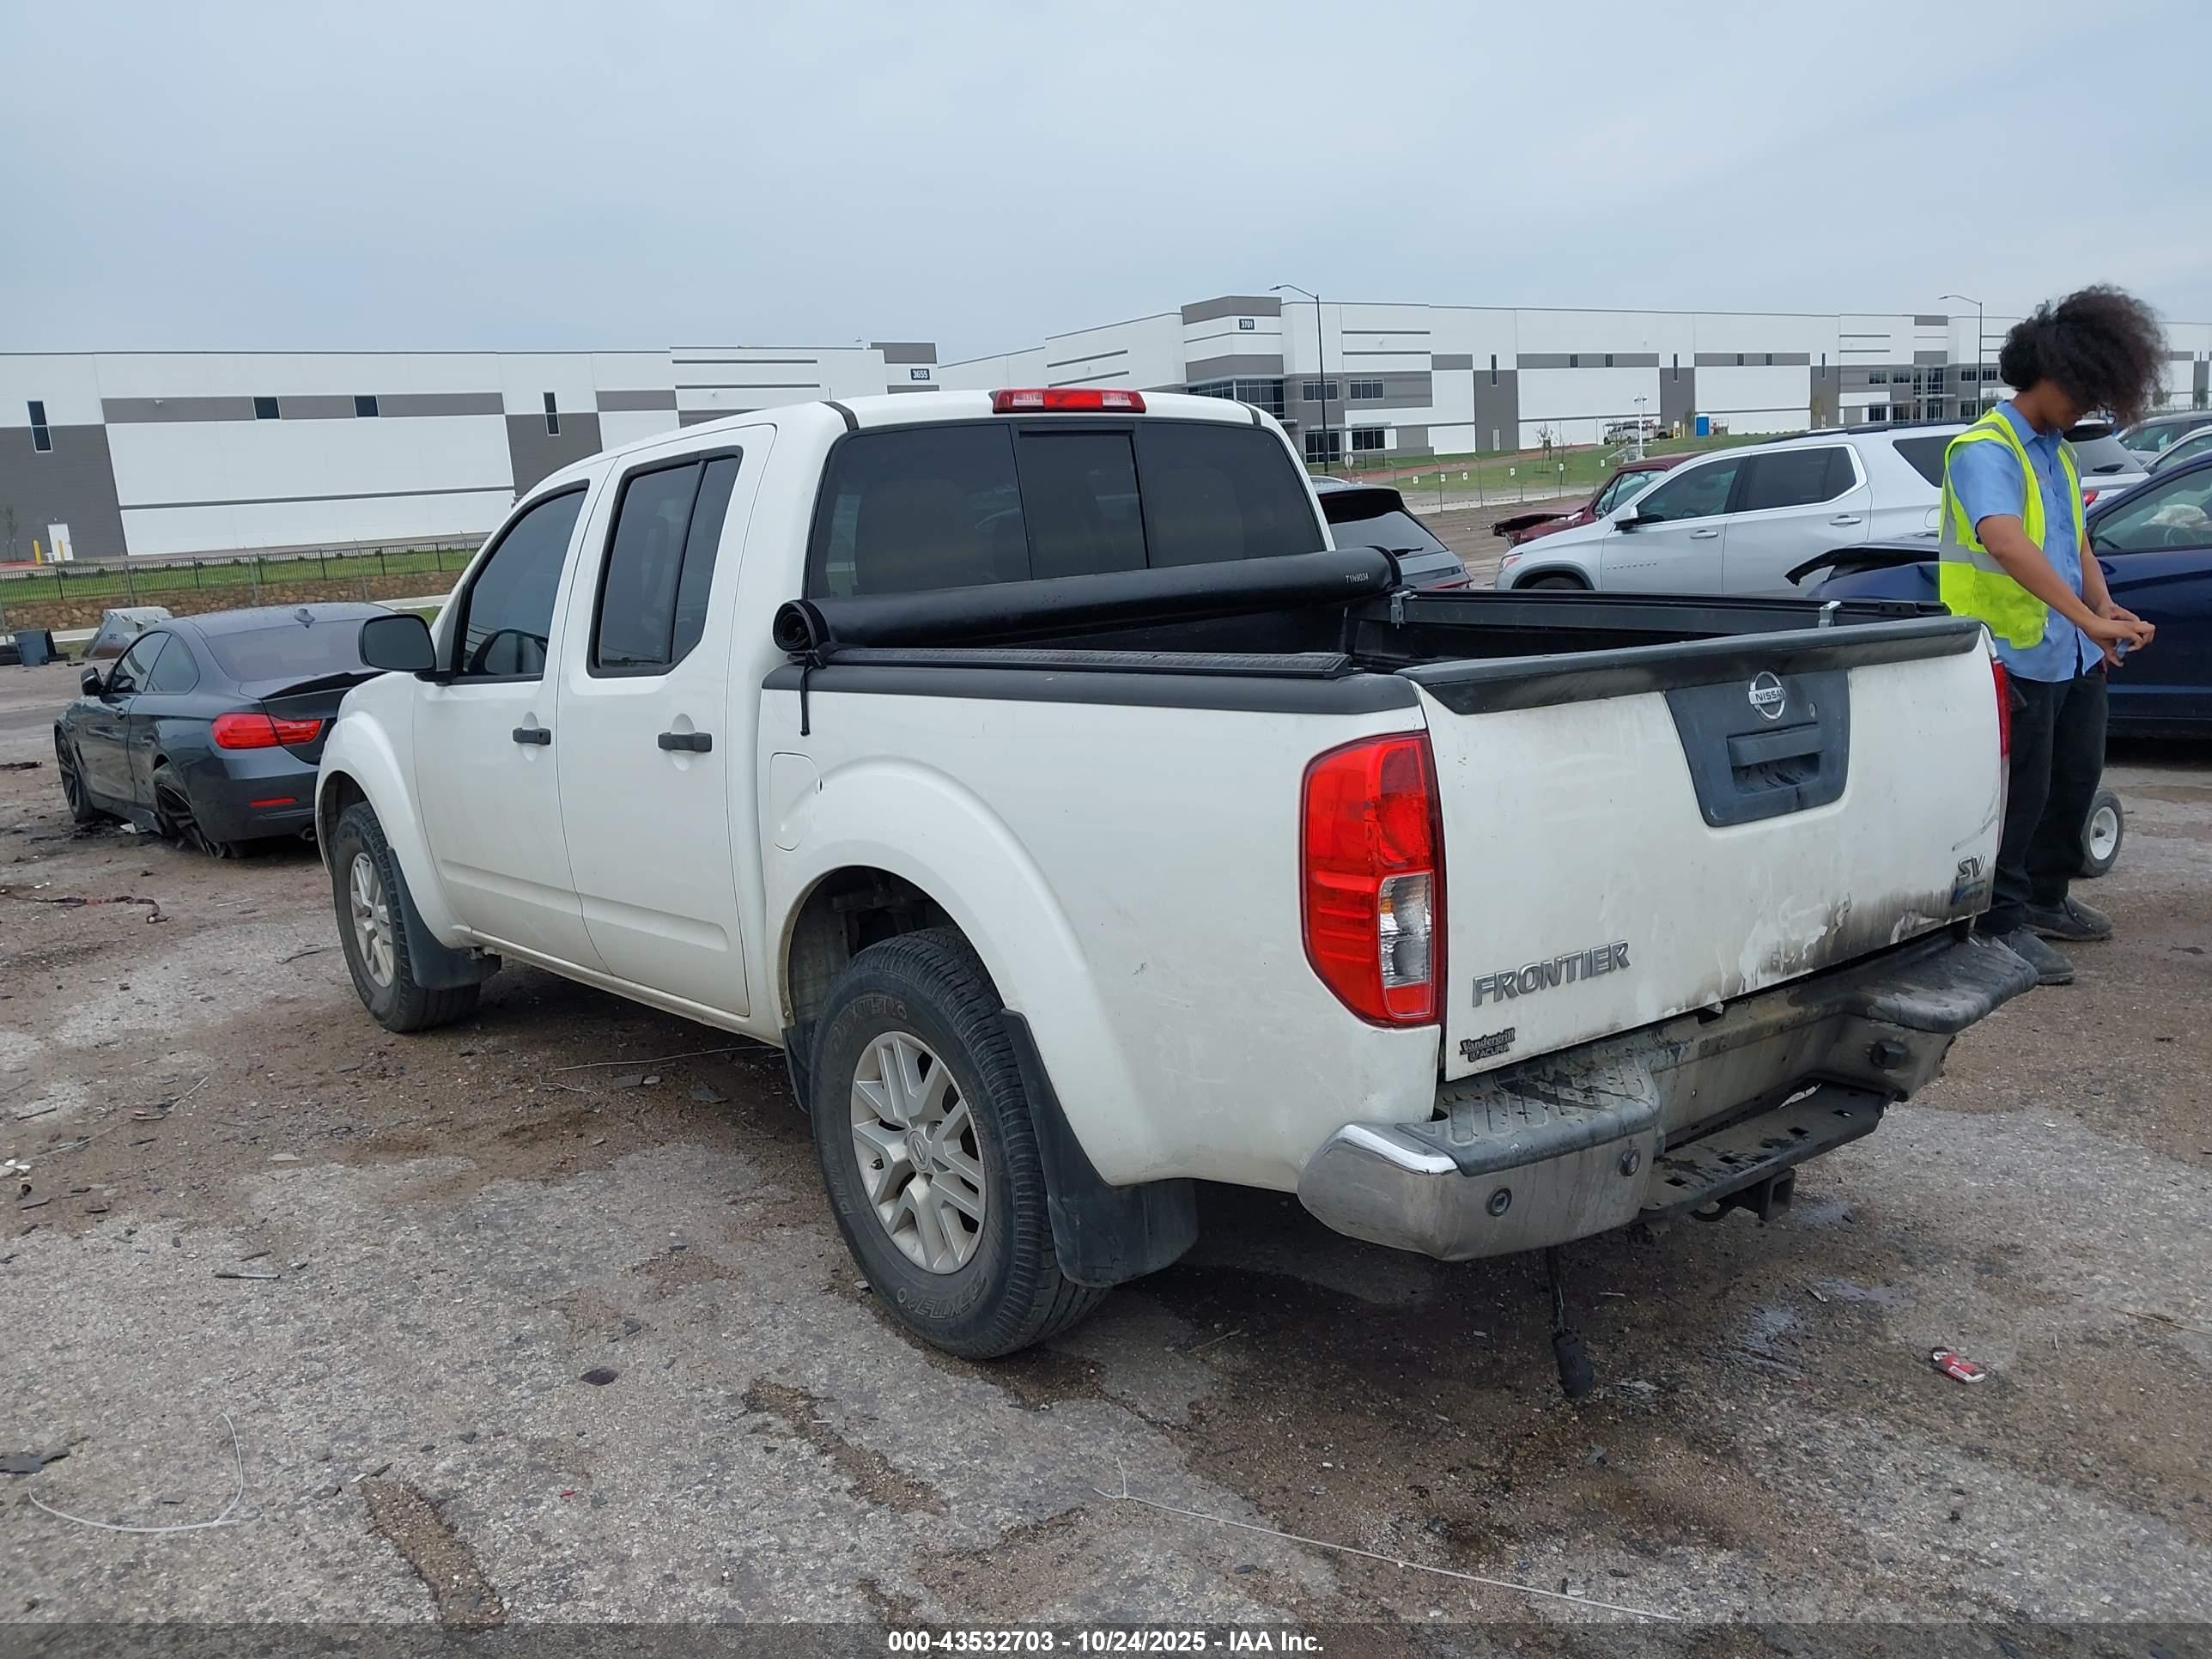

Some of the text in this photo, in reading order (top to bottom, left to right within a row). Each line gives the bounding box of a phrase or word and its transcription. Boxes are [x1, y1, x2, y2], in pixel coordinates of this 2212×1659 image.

[1240, 319, 1254, 329] 3701
[912, 370, 928, 379] 3655
[1754, 688, 1784, 702] NISSAN
[1955, 851, 1986, 878] SV
[1473, 939, 1631, 1008] FRONTIER
[1480, 1043, 1510, 1058] ACURA
